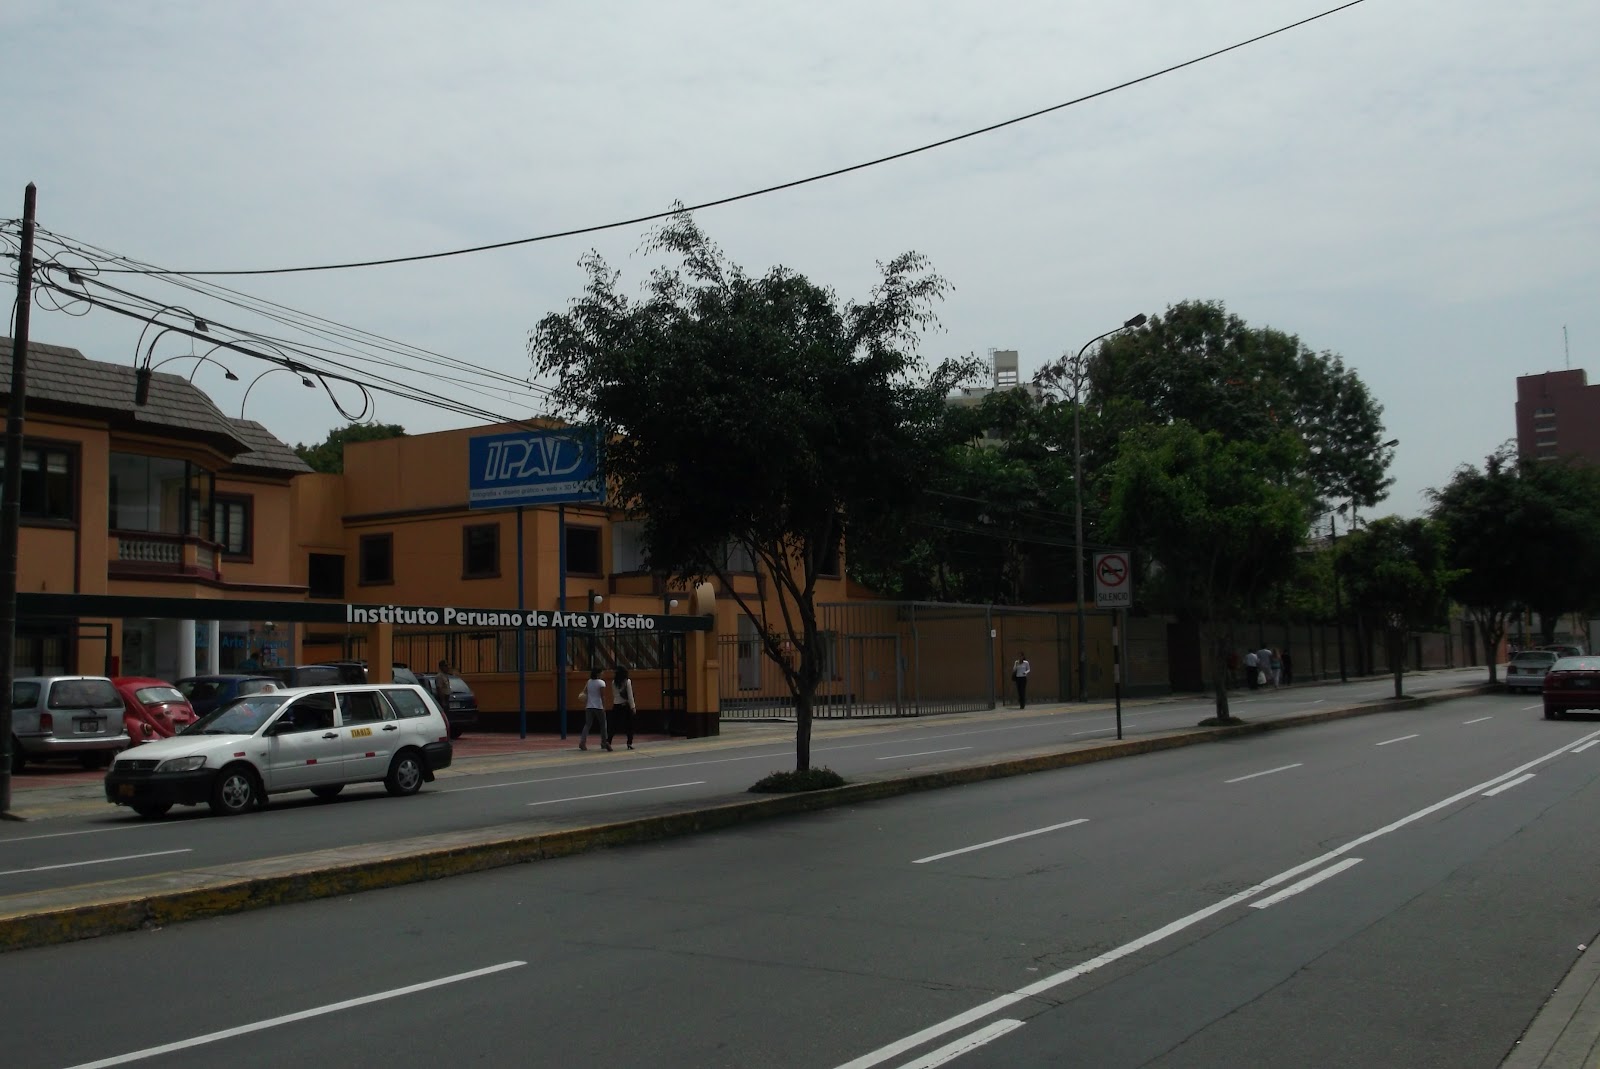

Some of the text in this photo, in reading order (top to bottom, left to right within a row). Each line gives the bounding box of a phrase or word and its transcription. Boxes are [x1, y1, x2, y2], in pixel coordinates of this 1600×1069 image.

[1098, 592, 1128, 602] SILENCIO
[346, 604, 655, 630] Instituto Peruano de Arte y Diseño
